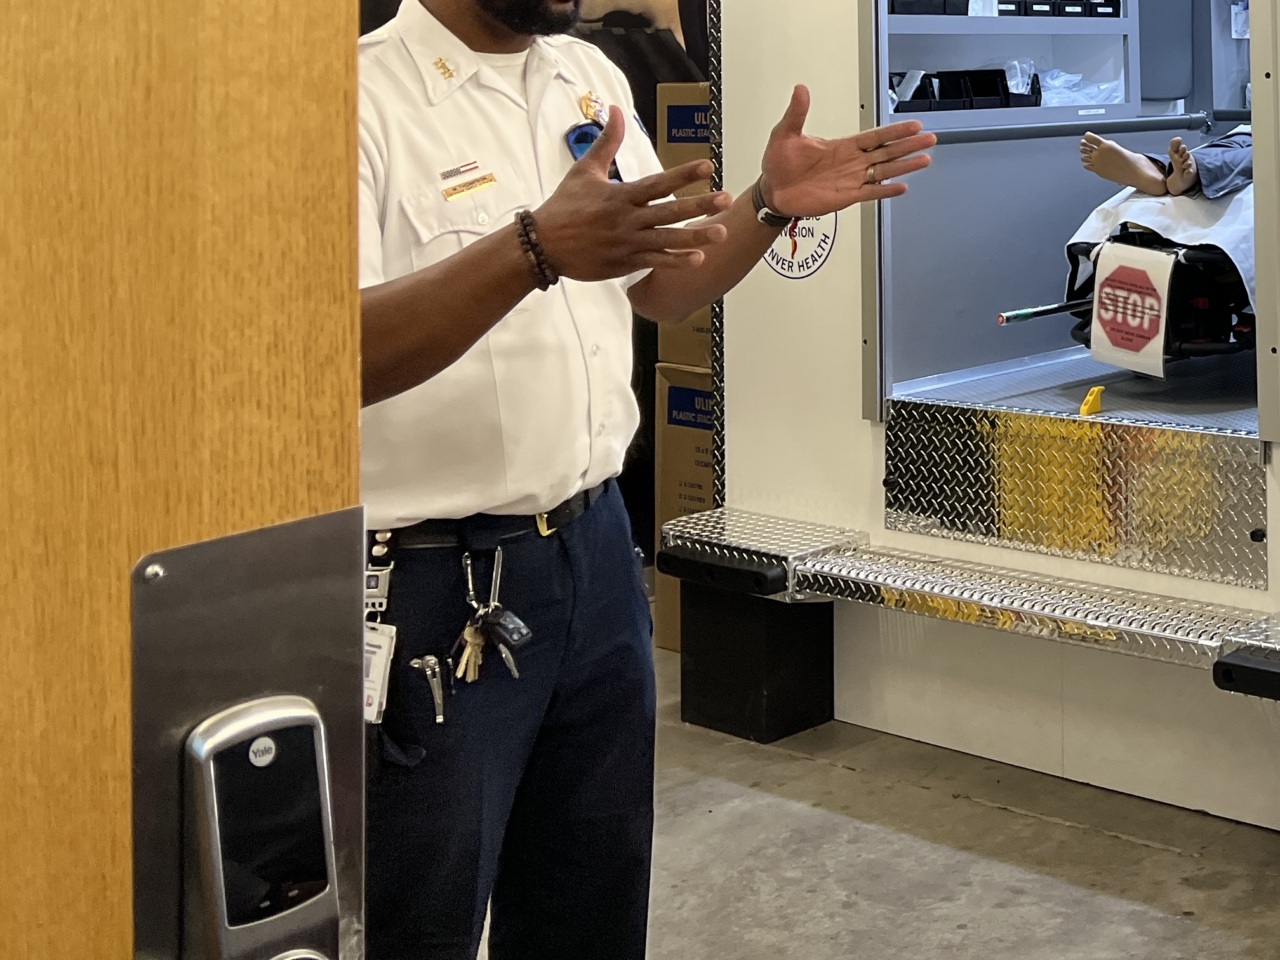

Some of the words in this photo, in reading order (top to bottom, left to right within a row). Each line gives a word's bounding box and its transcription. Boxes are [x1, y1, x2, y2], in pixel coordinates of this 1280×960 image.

[672, 128, 695, 137] PLASTIC
[797, 233, 830, 272] HEALTH
[1100, 287, 1161, 330] STOP
[672, 410, 695, 422] PLASTIC
[252, 746, 273, 759] Yale
